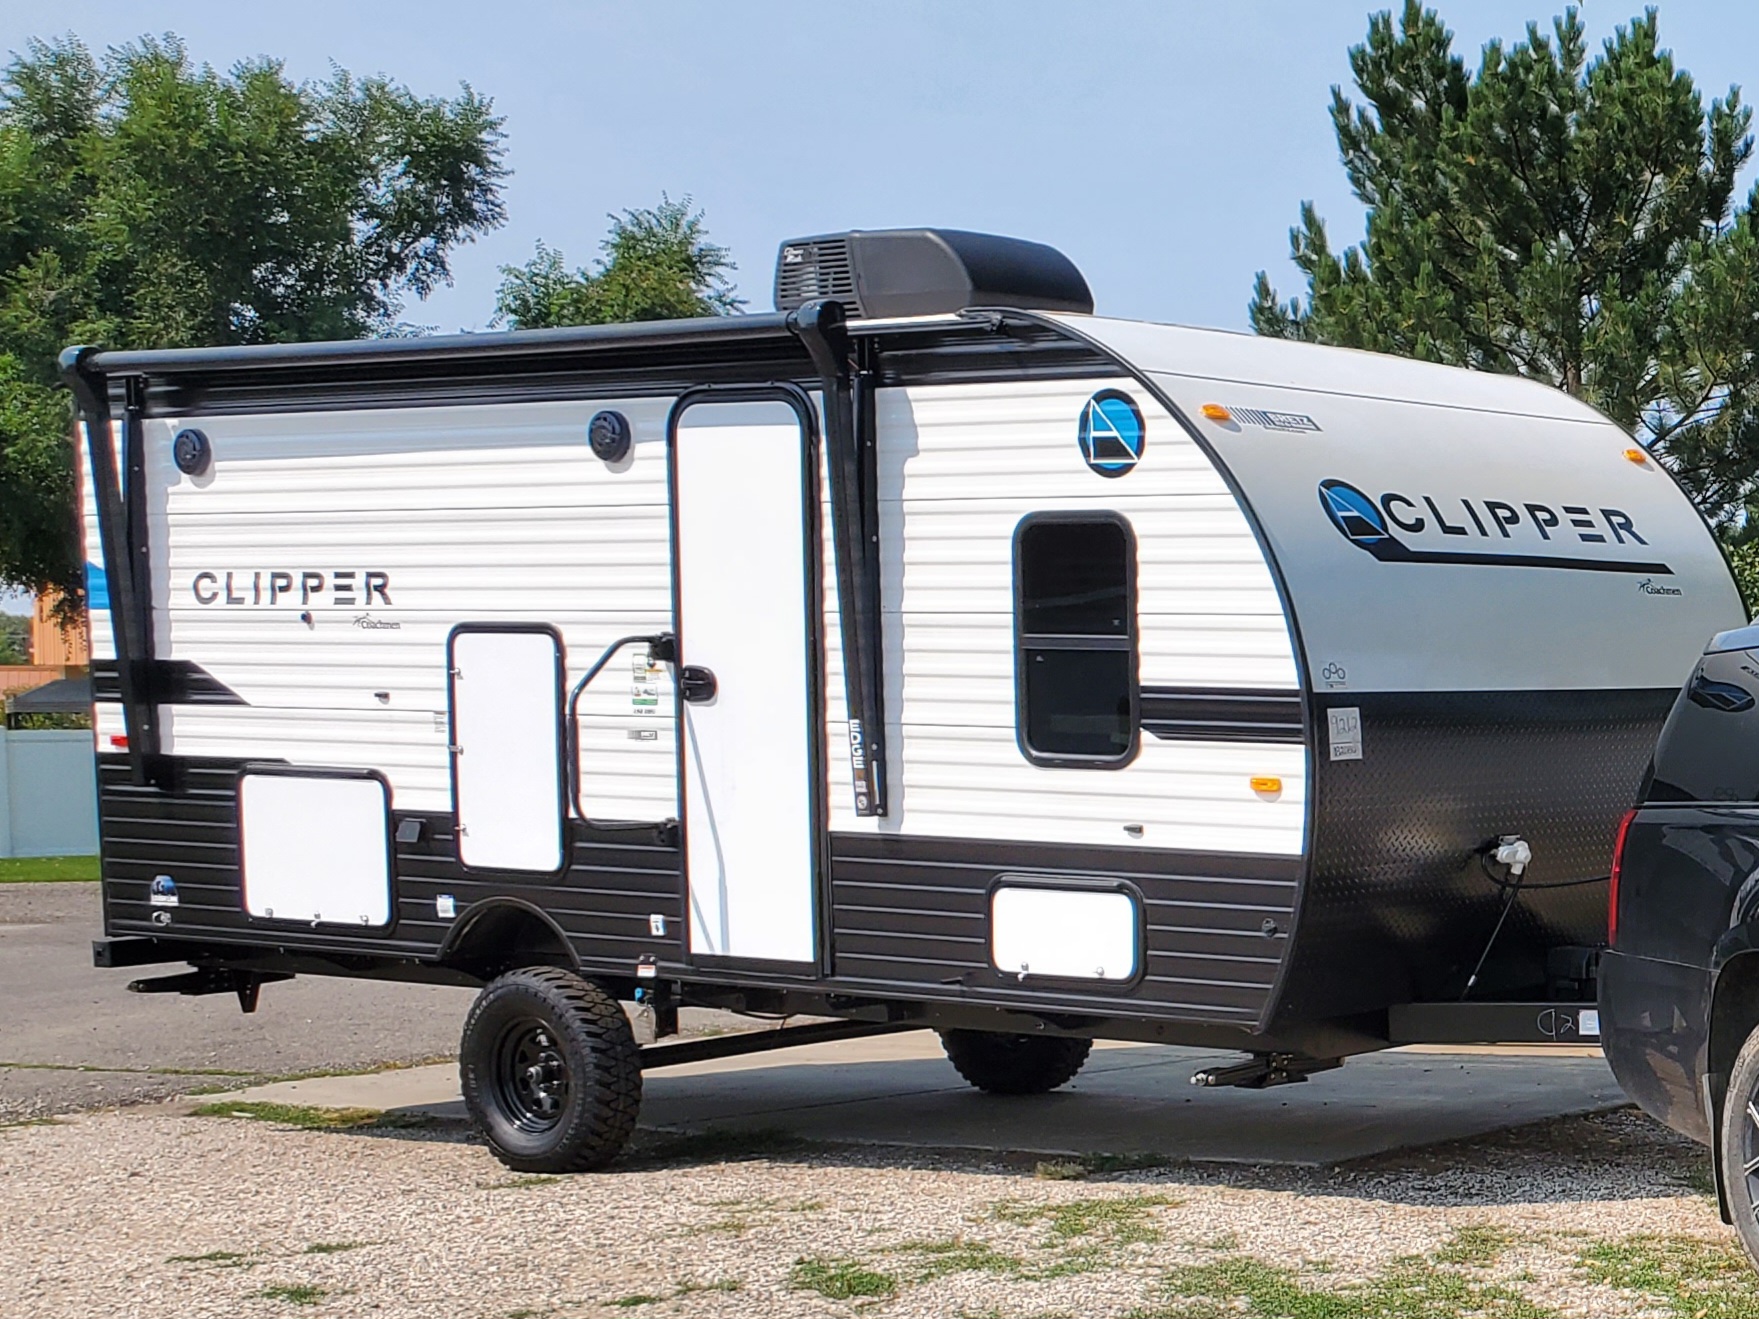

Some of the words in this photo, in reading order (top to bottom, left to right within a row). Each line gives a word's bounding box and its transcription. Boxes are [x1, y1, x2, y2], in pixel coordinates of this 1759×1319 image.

[1380, 492, 1650, 545] CLIPPER
[193, 571, 393, 605] CLIPPER
[849, 719, 865, 768] EDGE
